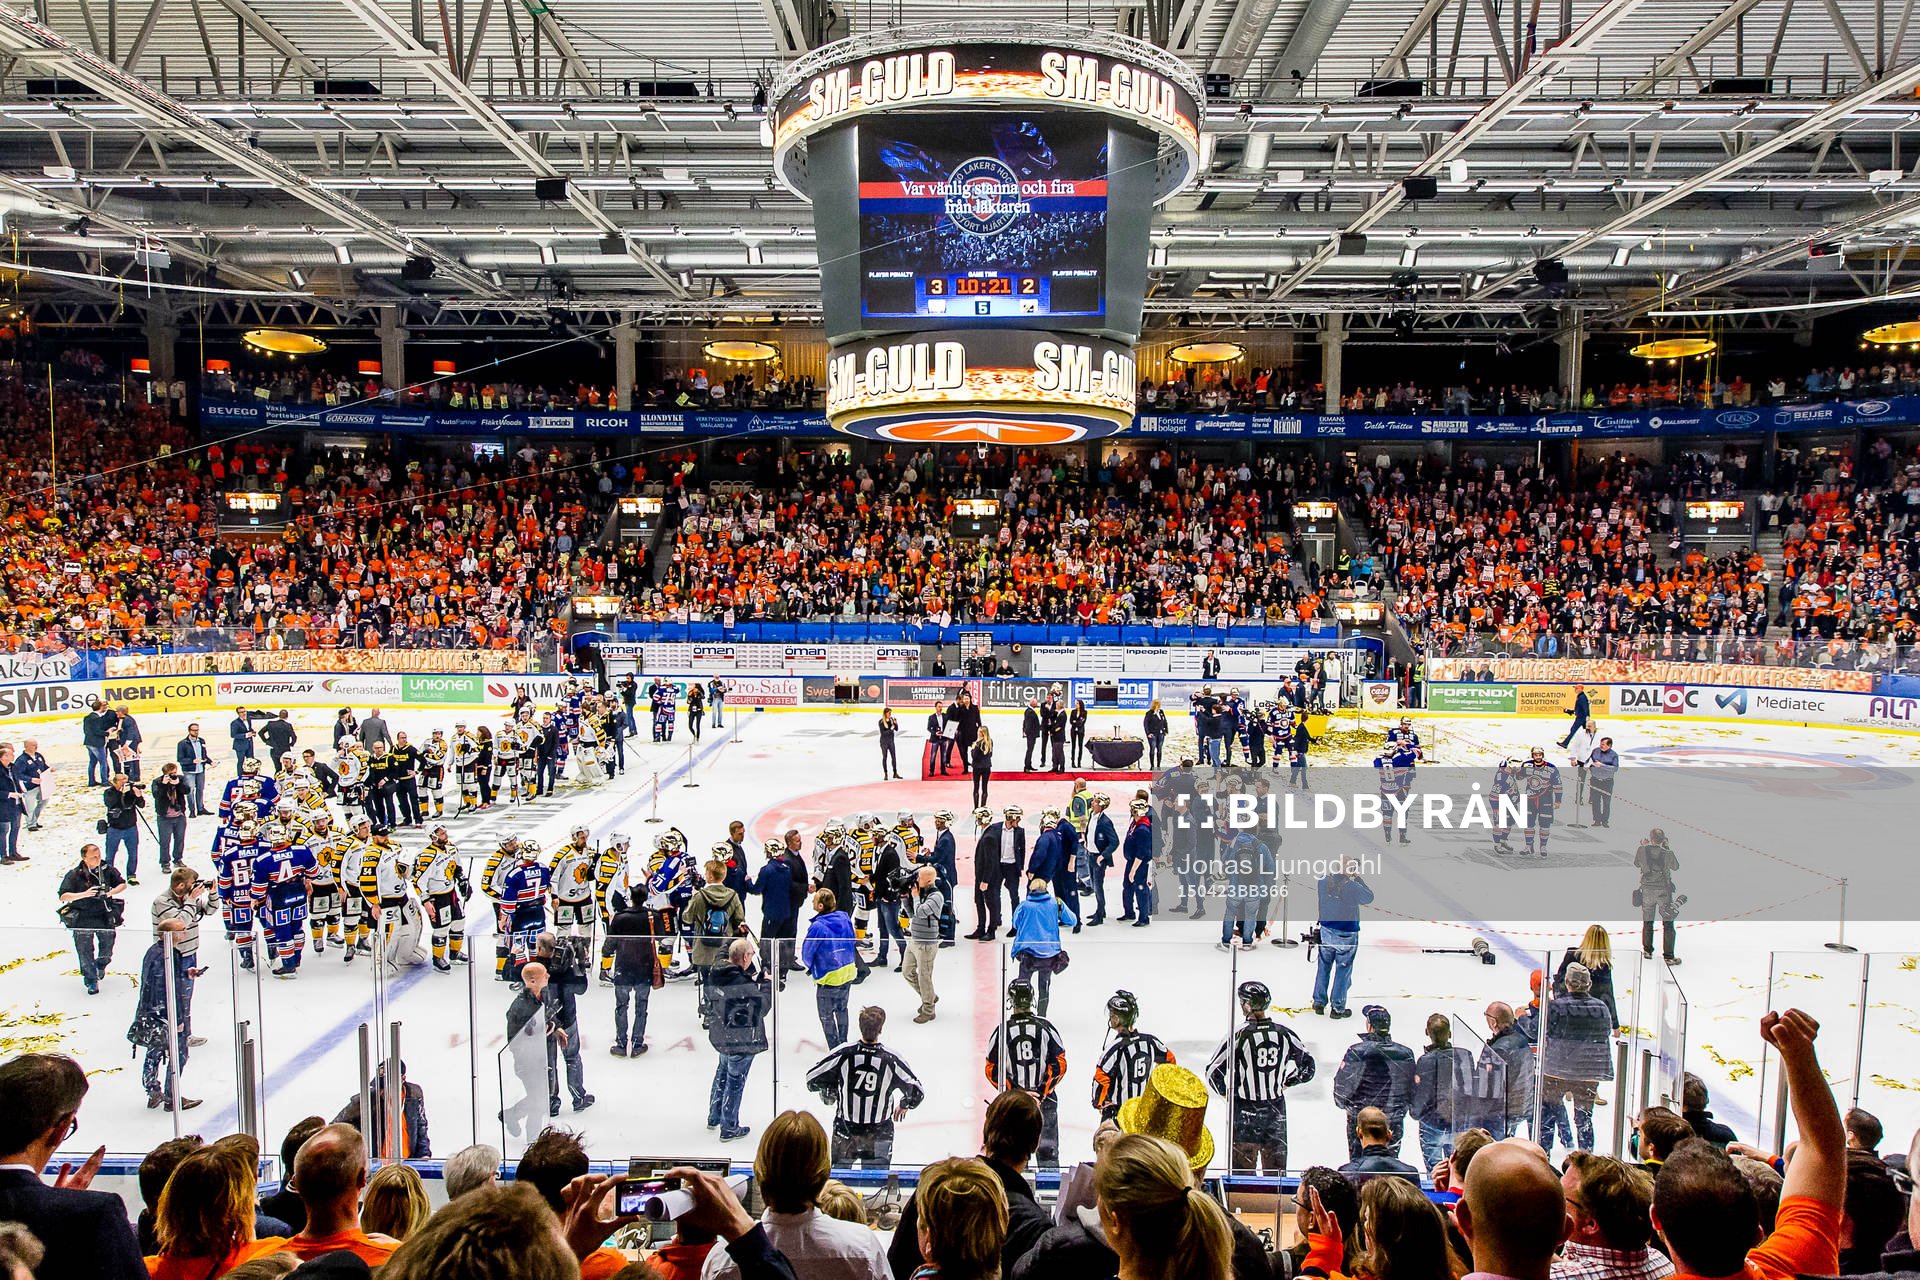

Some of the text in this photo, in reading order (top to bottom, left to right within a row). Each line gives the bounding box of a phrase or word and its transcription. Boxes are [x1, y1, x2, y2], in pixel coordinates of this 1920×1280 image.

[808, 51, 955, 122] SM-GULD
[1040, 52, 1176, 125] SM-GULD
[900, 179, 1075, 199] Var vänlig stanna och fira
[944, 199, 1030, 215] från läktaren
[931, 279, 943, 295] 3
[957, 278, 1012, 294] 10:21
[1023, 279, 1035, 294] 2
[829, 342, 966, 404] SM-GULD
[208, 406, 258, 416] BEVEGO
[1794, 410, 1833, 419] BEIJER
[545, 418, 571, 427] Lindab
[586, 418, 628, 427] RICOH
[640, 414, 684, 422] KLONDYKE
[1158, 416, 1187, 425] Fönster
[1158, 424, 1187, 432] bolaget
[1274, 420, 1301, 434] REKOND
[602, 643, 643, 655] öman
[693, 644, 735, 655] öman
[784, 645, 826, 656] öman
[1033, 647, 1075, 655] inpeople
[1126, 648, 1168, 656] inpeople
[1219, 649, 1261, 657] inpeople
[233, 684, 314, 694] POWERPLAY
[335, 685, 399, 695] Arenastaden
[727, 678, 797, 694] Pro-Safe
[911, 686, 946, 694] LAMMHULTS
[1432, 688, 1514, 697] FORTNOX
[1621, 688, 1699, 708] DALOC
[725, 696, 797, 705] SECURITY SYSTEM
[1756, 696, 1825, 712] Mediatec
[240, 848, 258, 858] MAXI
[272, 851, 294, 862] MAXI
[277, 859, 295, 884] 4
[524, 869, 542, 879] MAXI
[526, 878, 543, 898] 7
[1016, 1041, 1034, 1061] 18
[1257, 1047, 1279, 1068] 83
[854, 1070, 878, 1092] 79
